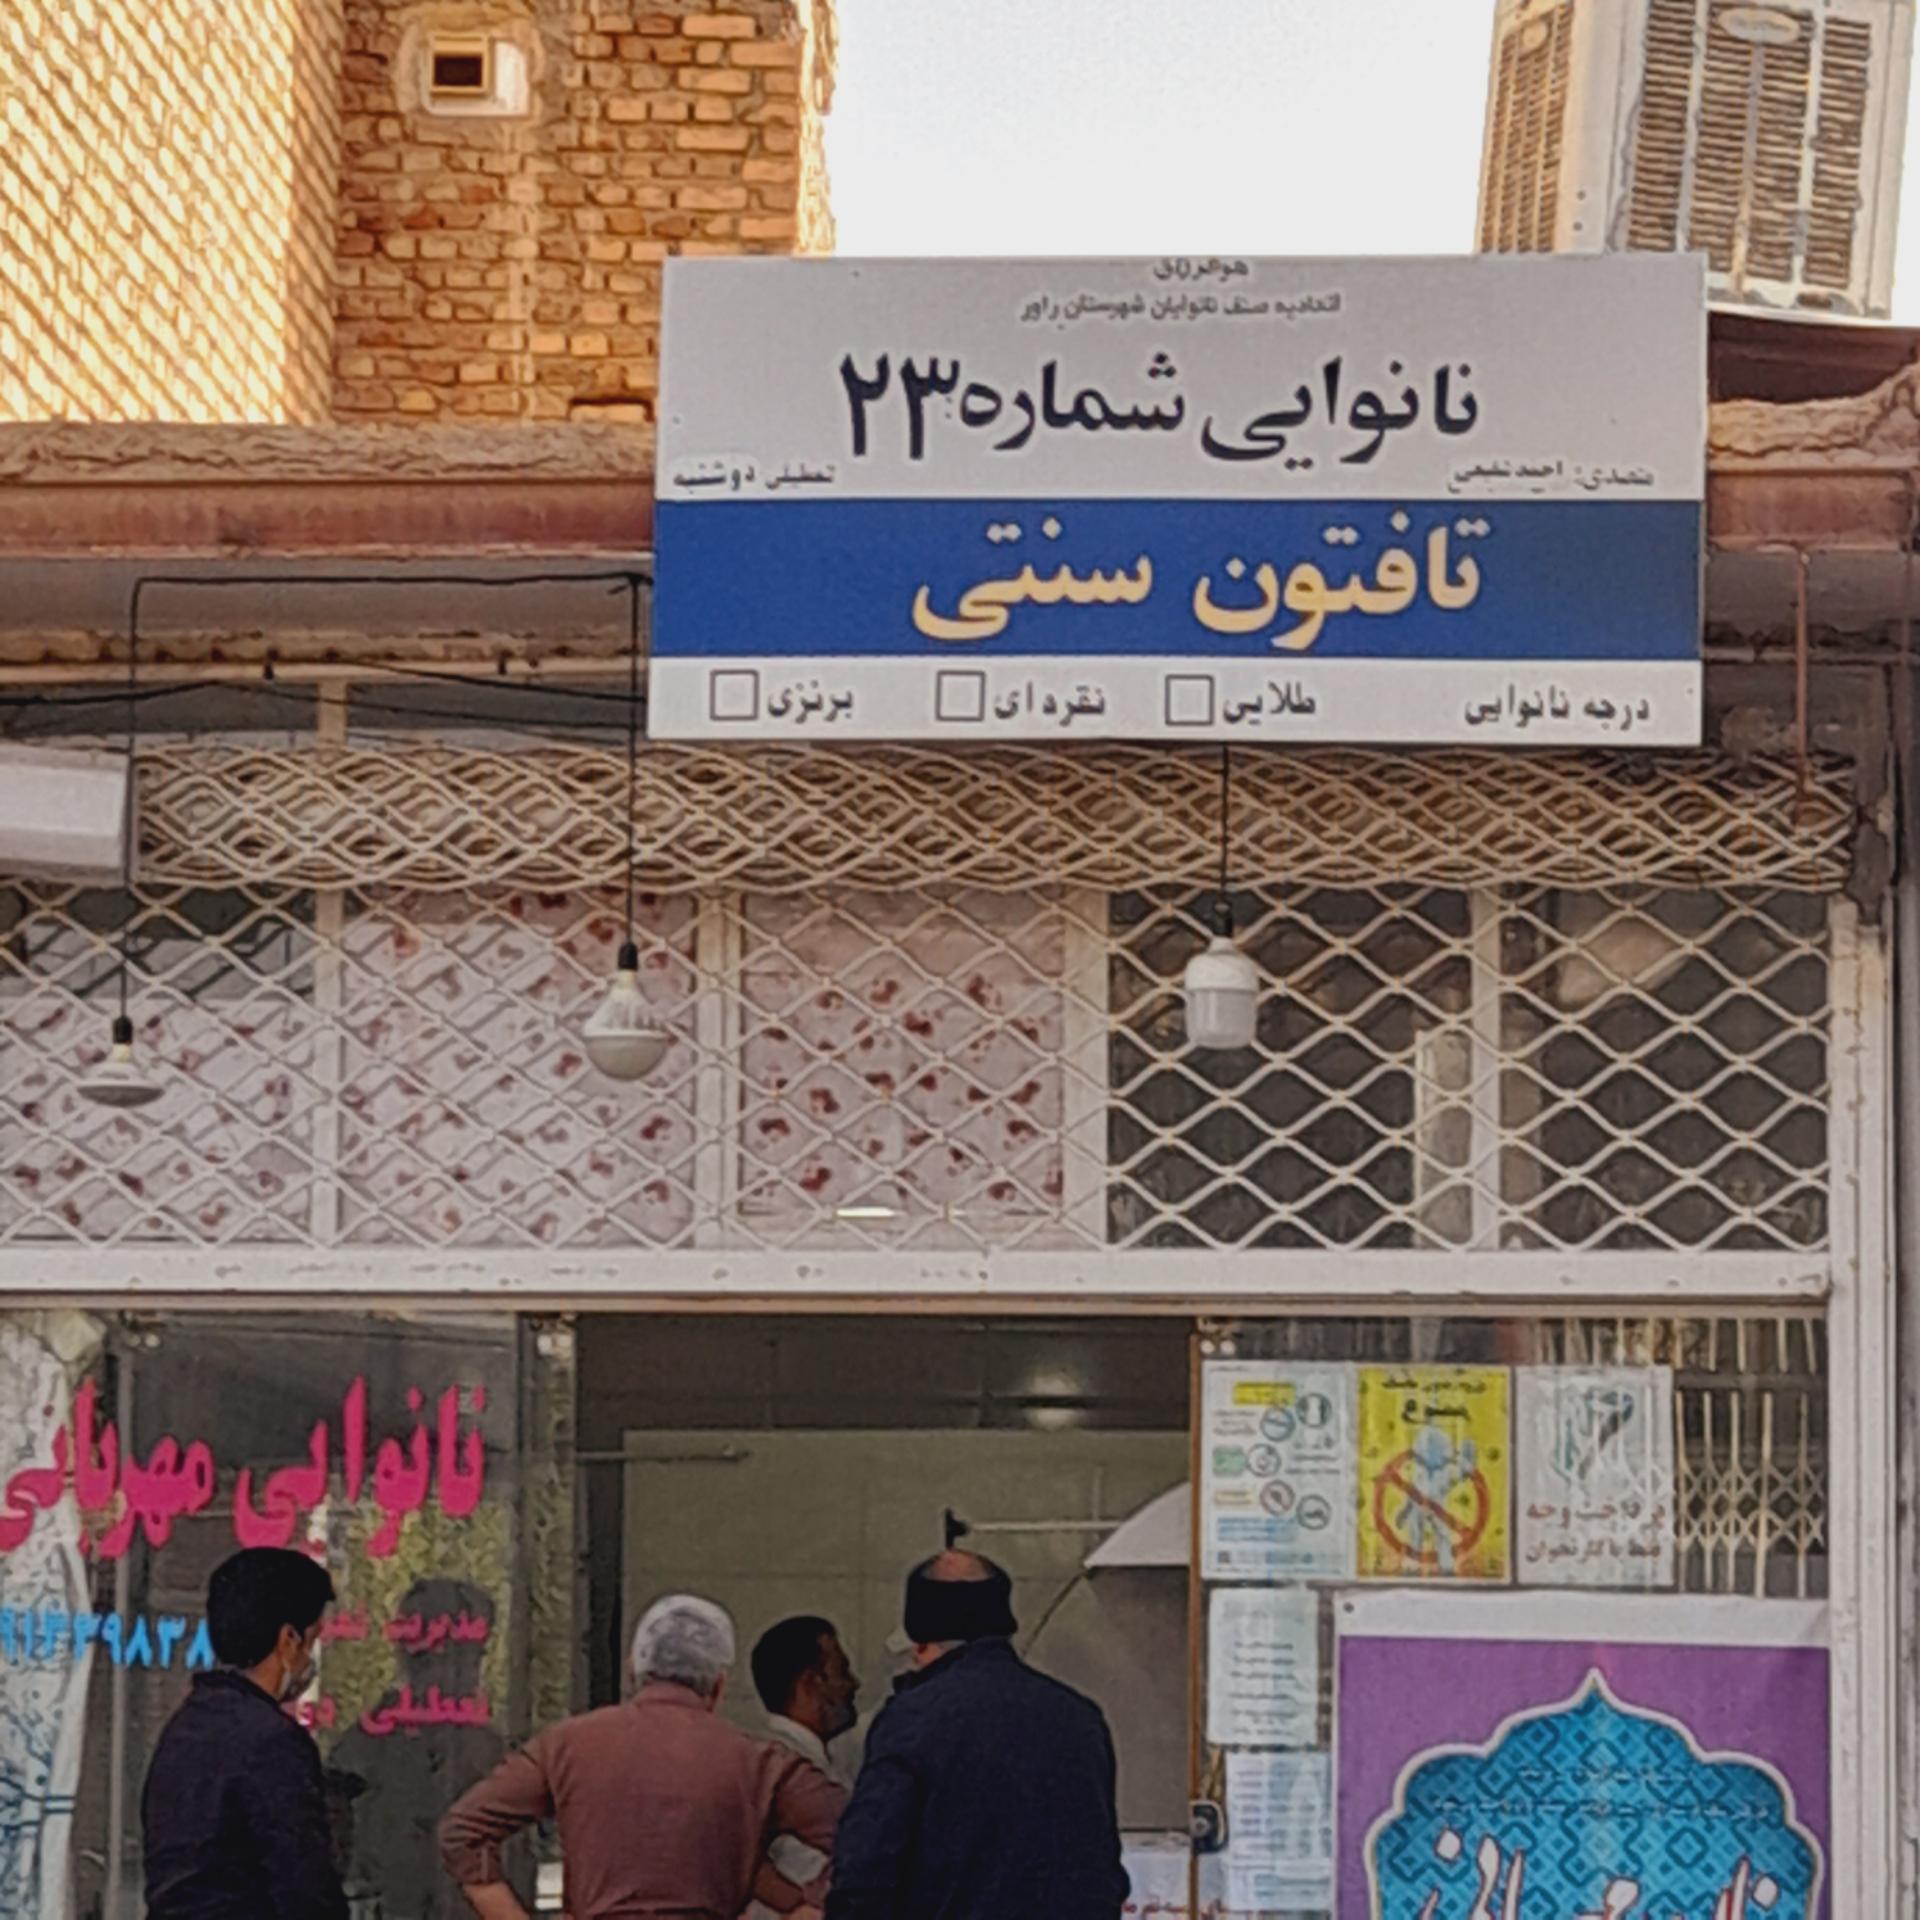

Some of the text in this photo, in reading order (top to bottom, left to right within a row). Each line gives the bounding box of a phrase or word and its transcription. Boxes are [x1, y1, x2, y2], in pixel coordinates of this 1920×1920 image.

[1062, 292, 1147, 321] شهرستان
[1200, 354, 1479, 471] نانوایی
[764, 462, 836, 490] تعطیلی
[912, 510, 1491, 651] تافتون سنتی
[767, 679, 855, 724] برنزی
[1222, 680, 1317, 725] طلایی
[1464, 684, 1651, 731] درجه نانوایی
[234, 1376, 485, 1558] نانوایی
